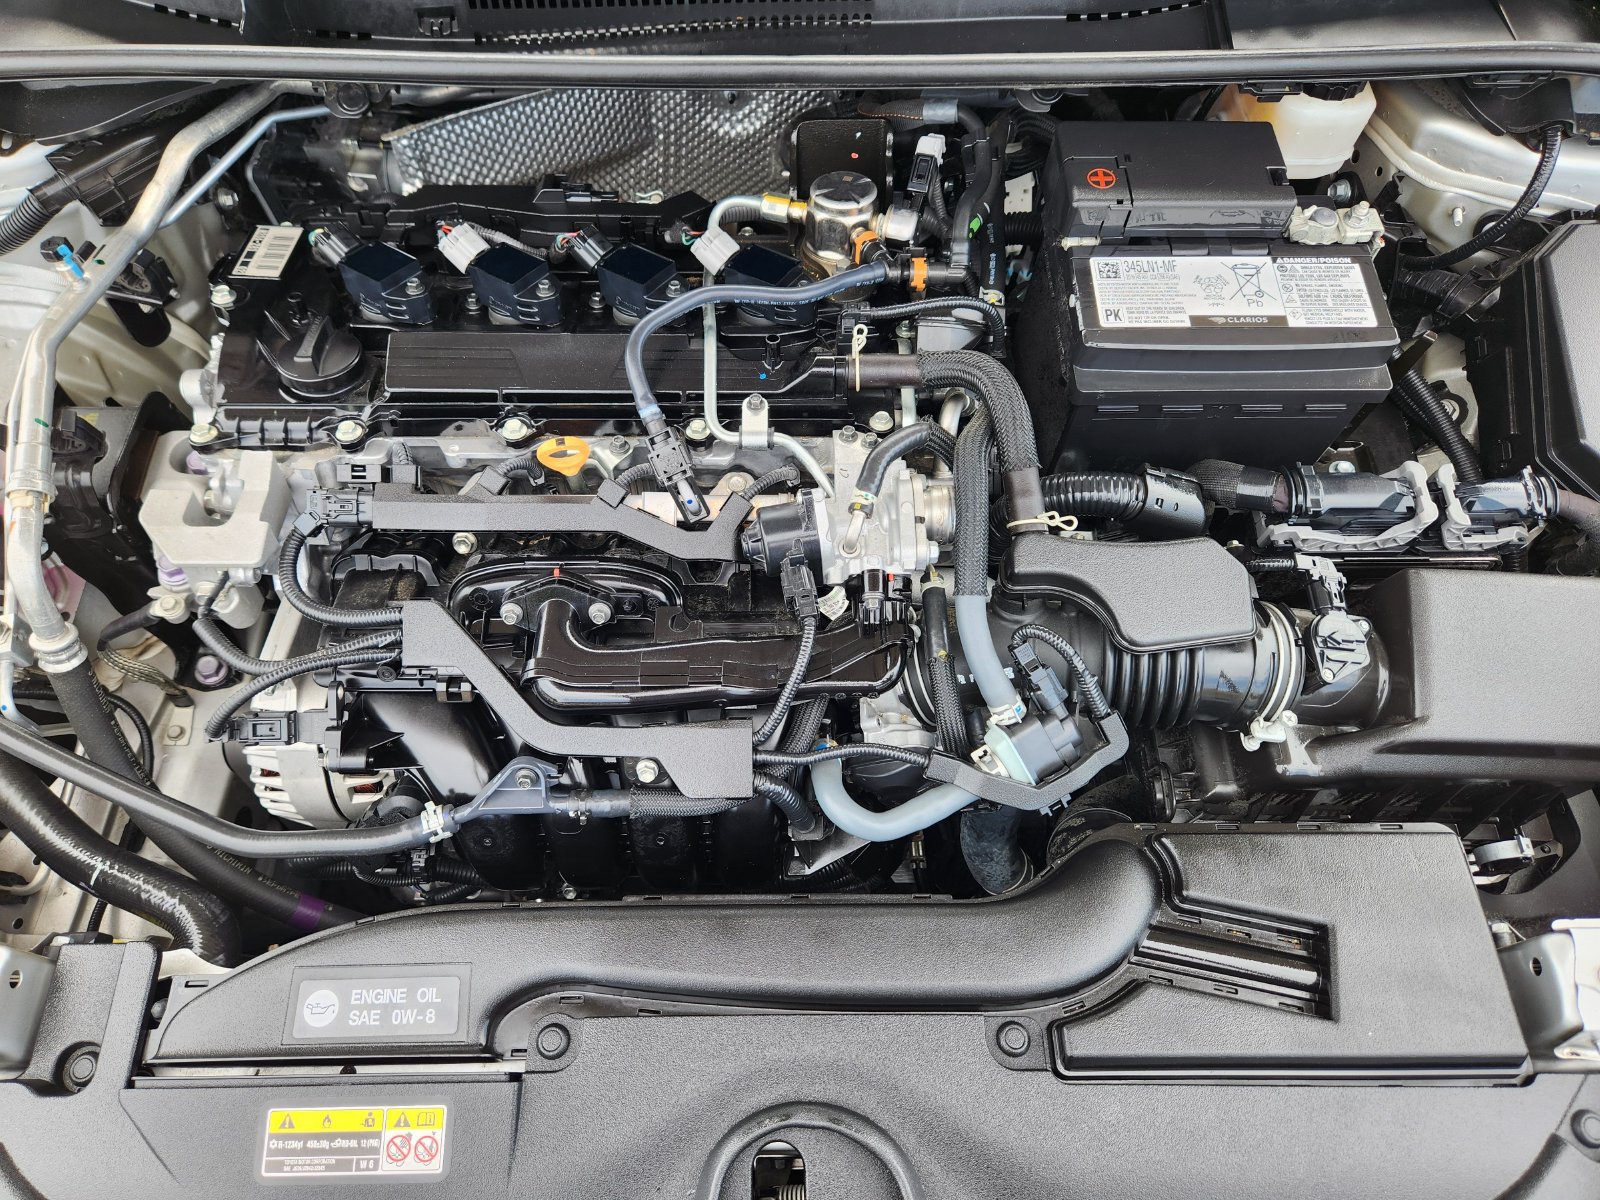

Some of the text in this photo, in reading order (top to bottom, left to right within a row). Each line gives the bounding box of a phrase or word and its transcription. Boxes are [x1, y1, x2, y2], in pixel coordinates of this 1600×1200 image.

[1124, 260, 1177, 273] 345LN1-MF
[1246, 299, 1264, 308] Pb
[1105, 308, 1123, 322] PK
[350, 987, 442, 1005] ENGINE OIL
[348, 1008, 436, 1026] SAE 0W-8
[360, 1159, 375, 1168] W 6
